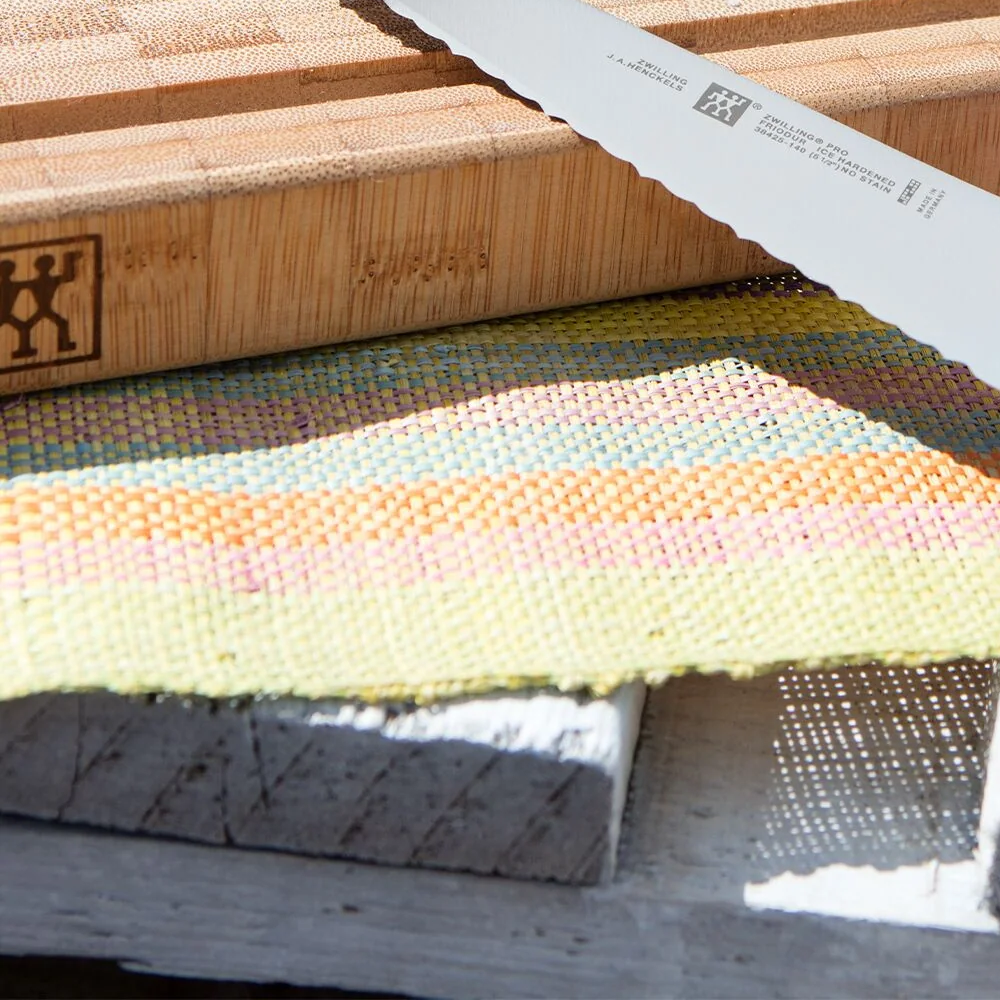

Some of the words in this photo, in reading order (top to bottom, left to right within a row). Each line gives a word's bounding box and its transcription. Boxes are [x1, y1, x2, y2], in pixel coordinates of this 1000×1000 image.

[637, 58, 689, 86] ZWILLING
[753, 126, 807, 154] 38425-140
[840, 166, 857, 178] NO
[859, 175, 892, 194] STAIN
[759, 119, 807, 146] FRIODUR
[816, 146, 836, 159] ICE
[837, 156, 896, 187] HARDENED
[826, 142, 849, 157] PRO
[916, 195, 933, 213] MADE
[923, 190, 946, 220] GERMANY
